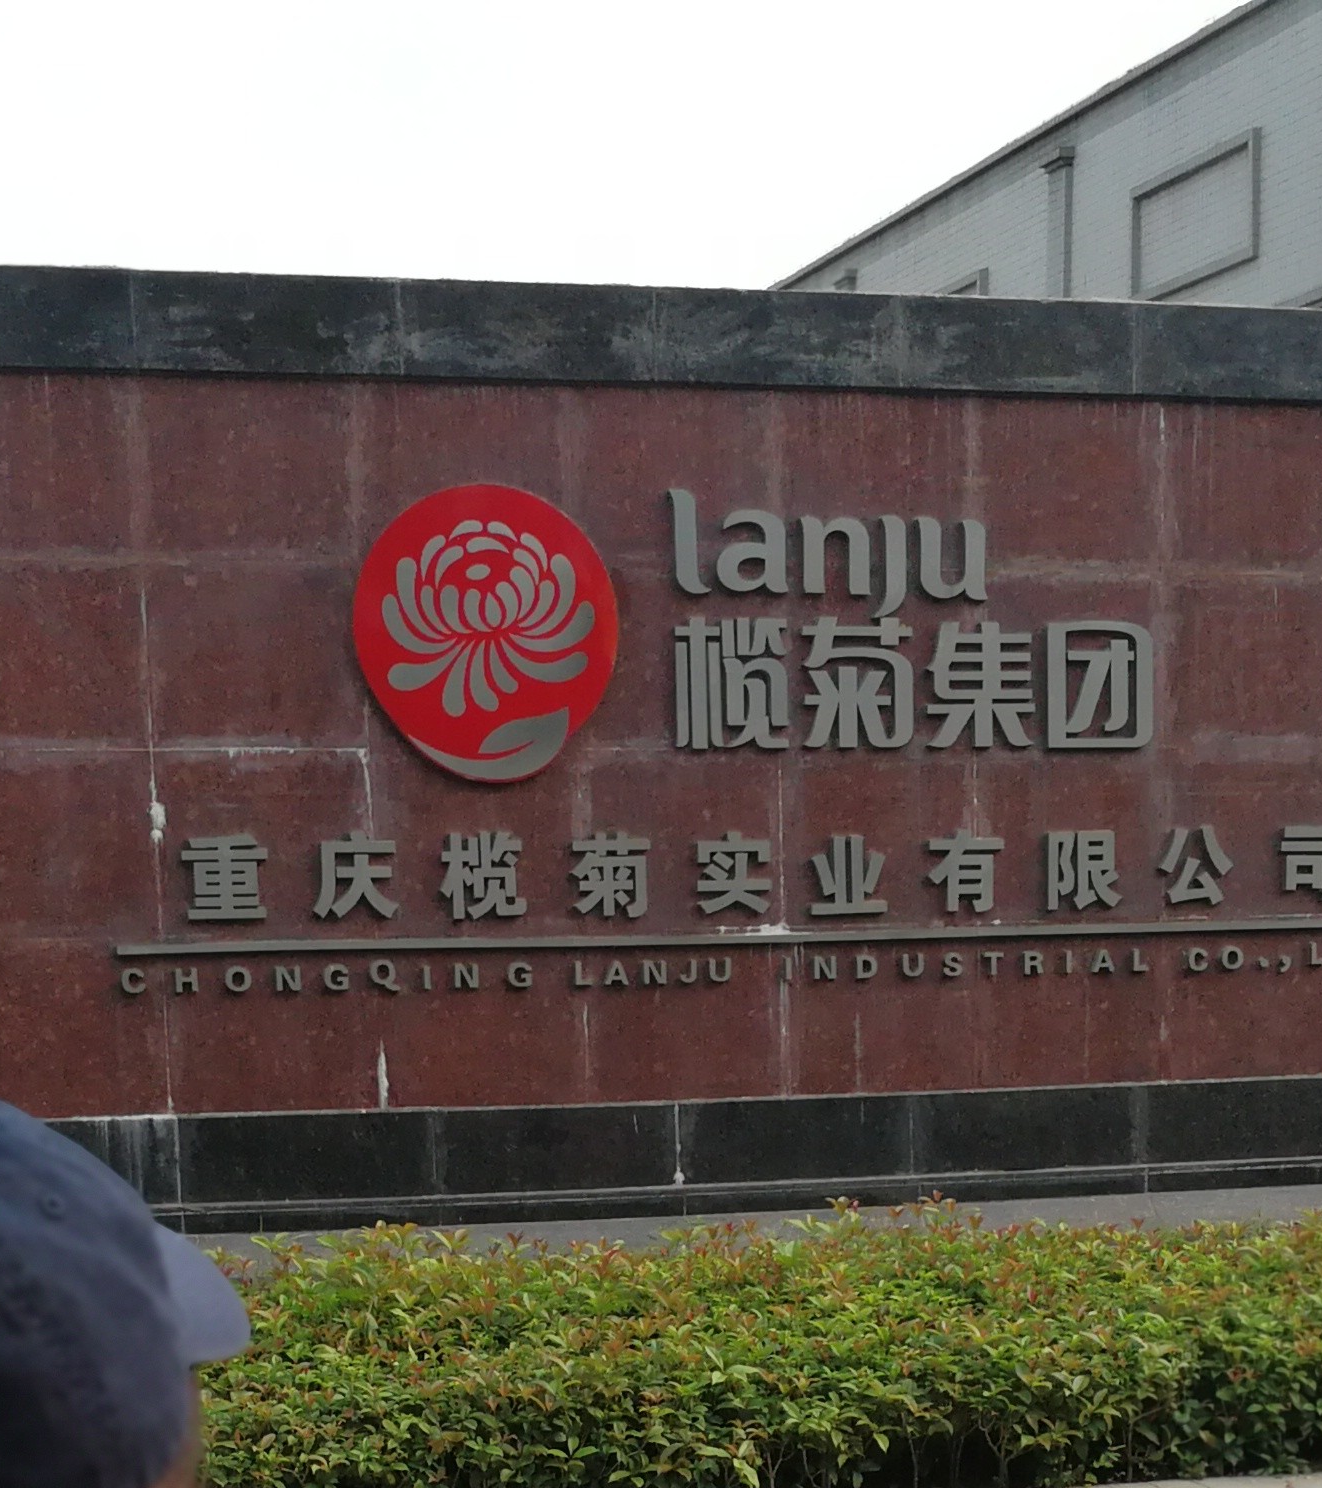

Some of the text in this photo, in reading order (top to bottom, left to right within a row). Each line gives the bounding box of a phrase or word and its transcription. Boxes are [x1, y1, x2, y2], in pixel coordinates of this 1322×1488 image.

[668, 489, 988, 619] lanju
[674, 616, 1154, 750] 榄菊集团
[120, 959, 535, 995] CHONGQING
[574, 956, 733, 988] LANJU
[783, 948, 1149, 981] INDUSTRIAL
